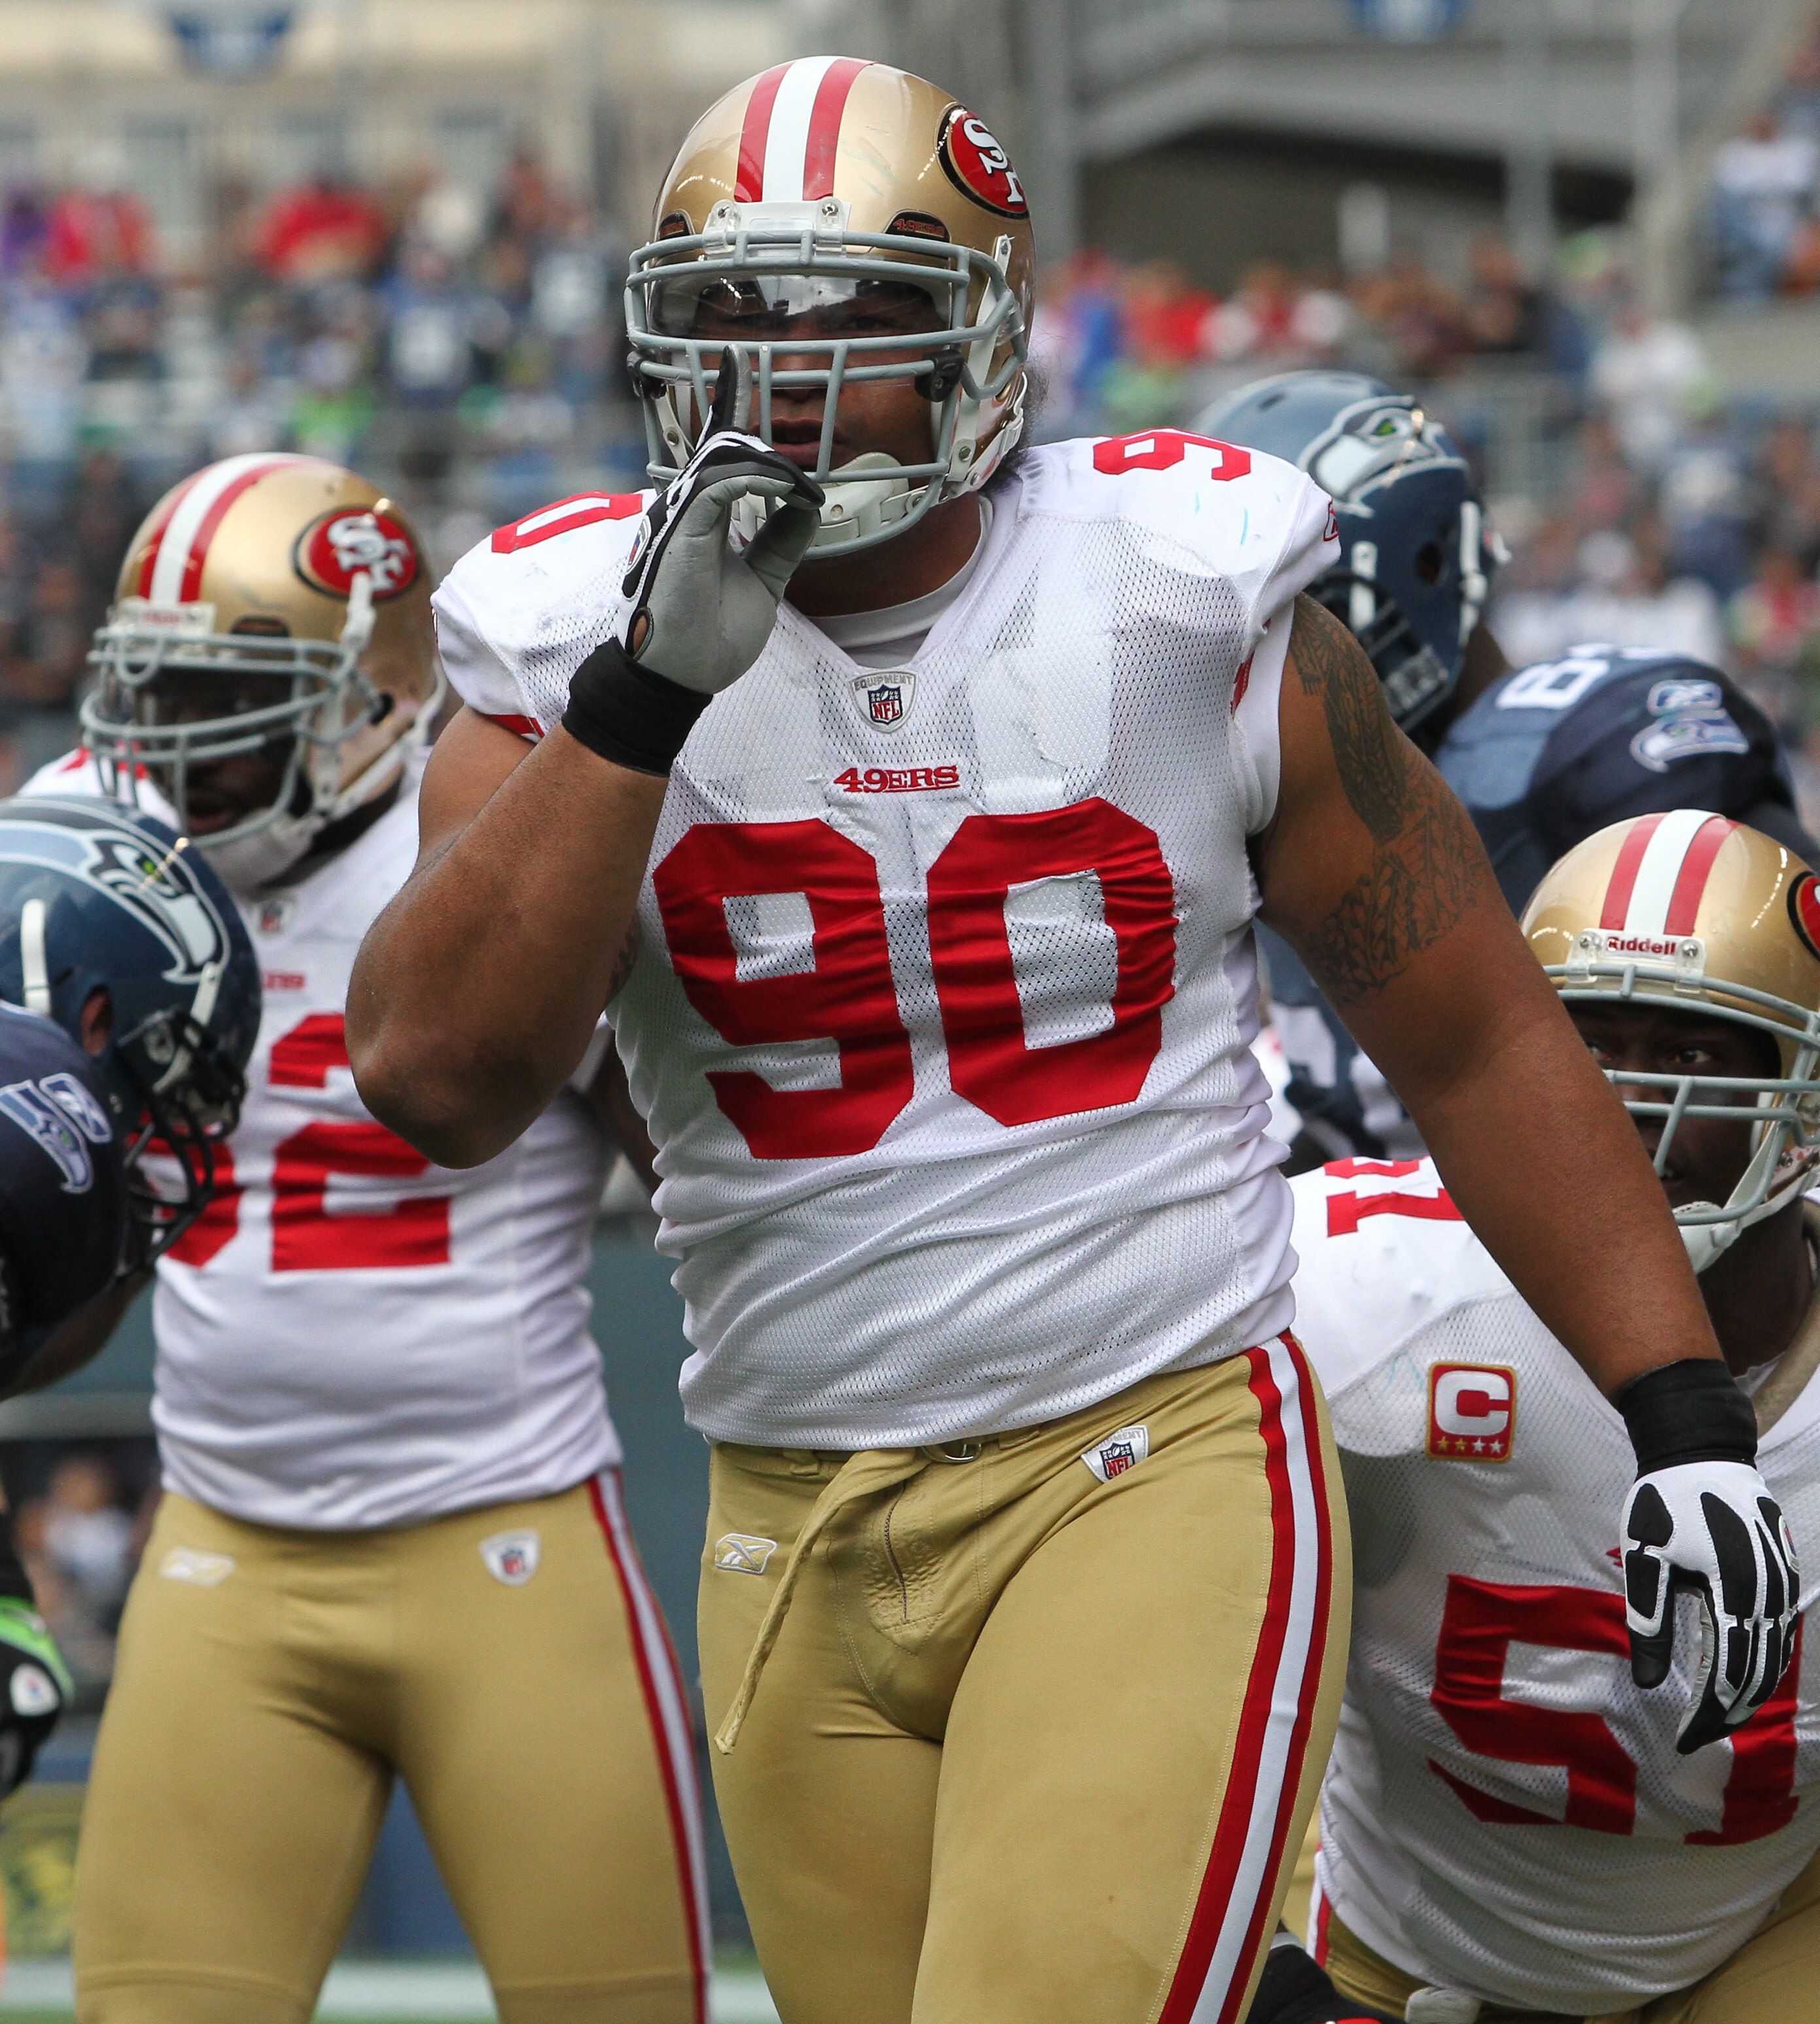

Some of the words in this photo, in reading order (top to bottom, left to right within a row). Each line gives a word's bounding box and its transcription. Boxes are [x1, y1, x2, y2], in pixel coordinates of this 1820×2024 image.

[1093, 427, 1251, 481] 9
[853, 674, 912, 691] EQUIPMENT
[872, 701, 900, 720] NFL
[833, 765, 960, 792] 49ERS
[1607, 936, 1676, 955] Riddell
[652, 796, 1180, 1160] 90
[1435, 1370, 1510, 1437] C
[1428, 1573, 1804, 1846] 51
